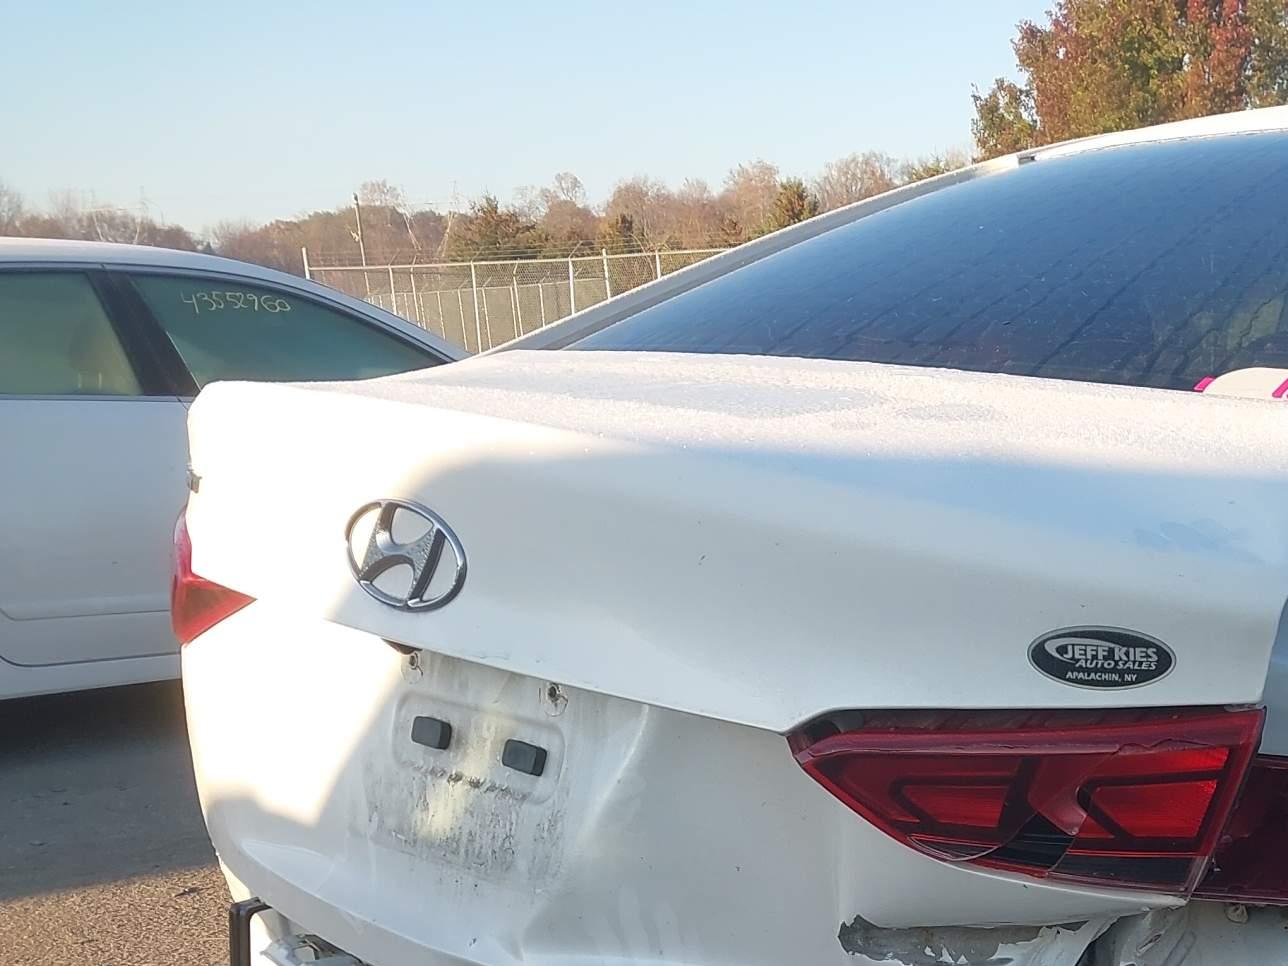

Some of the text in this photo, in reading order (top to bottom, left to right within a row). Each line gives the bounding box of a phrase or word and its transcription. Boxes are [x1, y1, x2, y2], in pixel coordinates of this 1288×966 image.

[181, 291, 291, 314] 43552960
[1063, 644, 1159, 662] JEFF KIES
[1075, 659, 1158, 671] AUTO SALES
[1065, 671, 1137, 683] APALACHIN, NY
